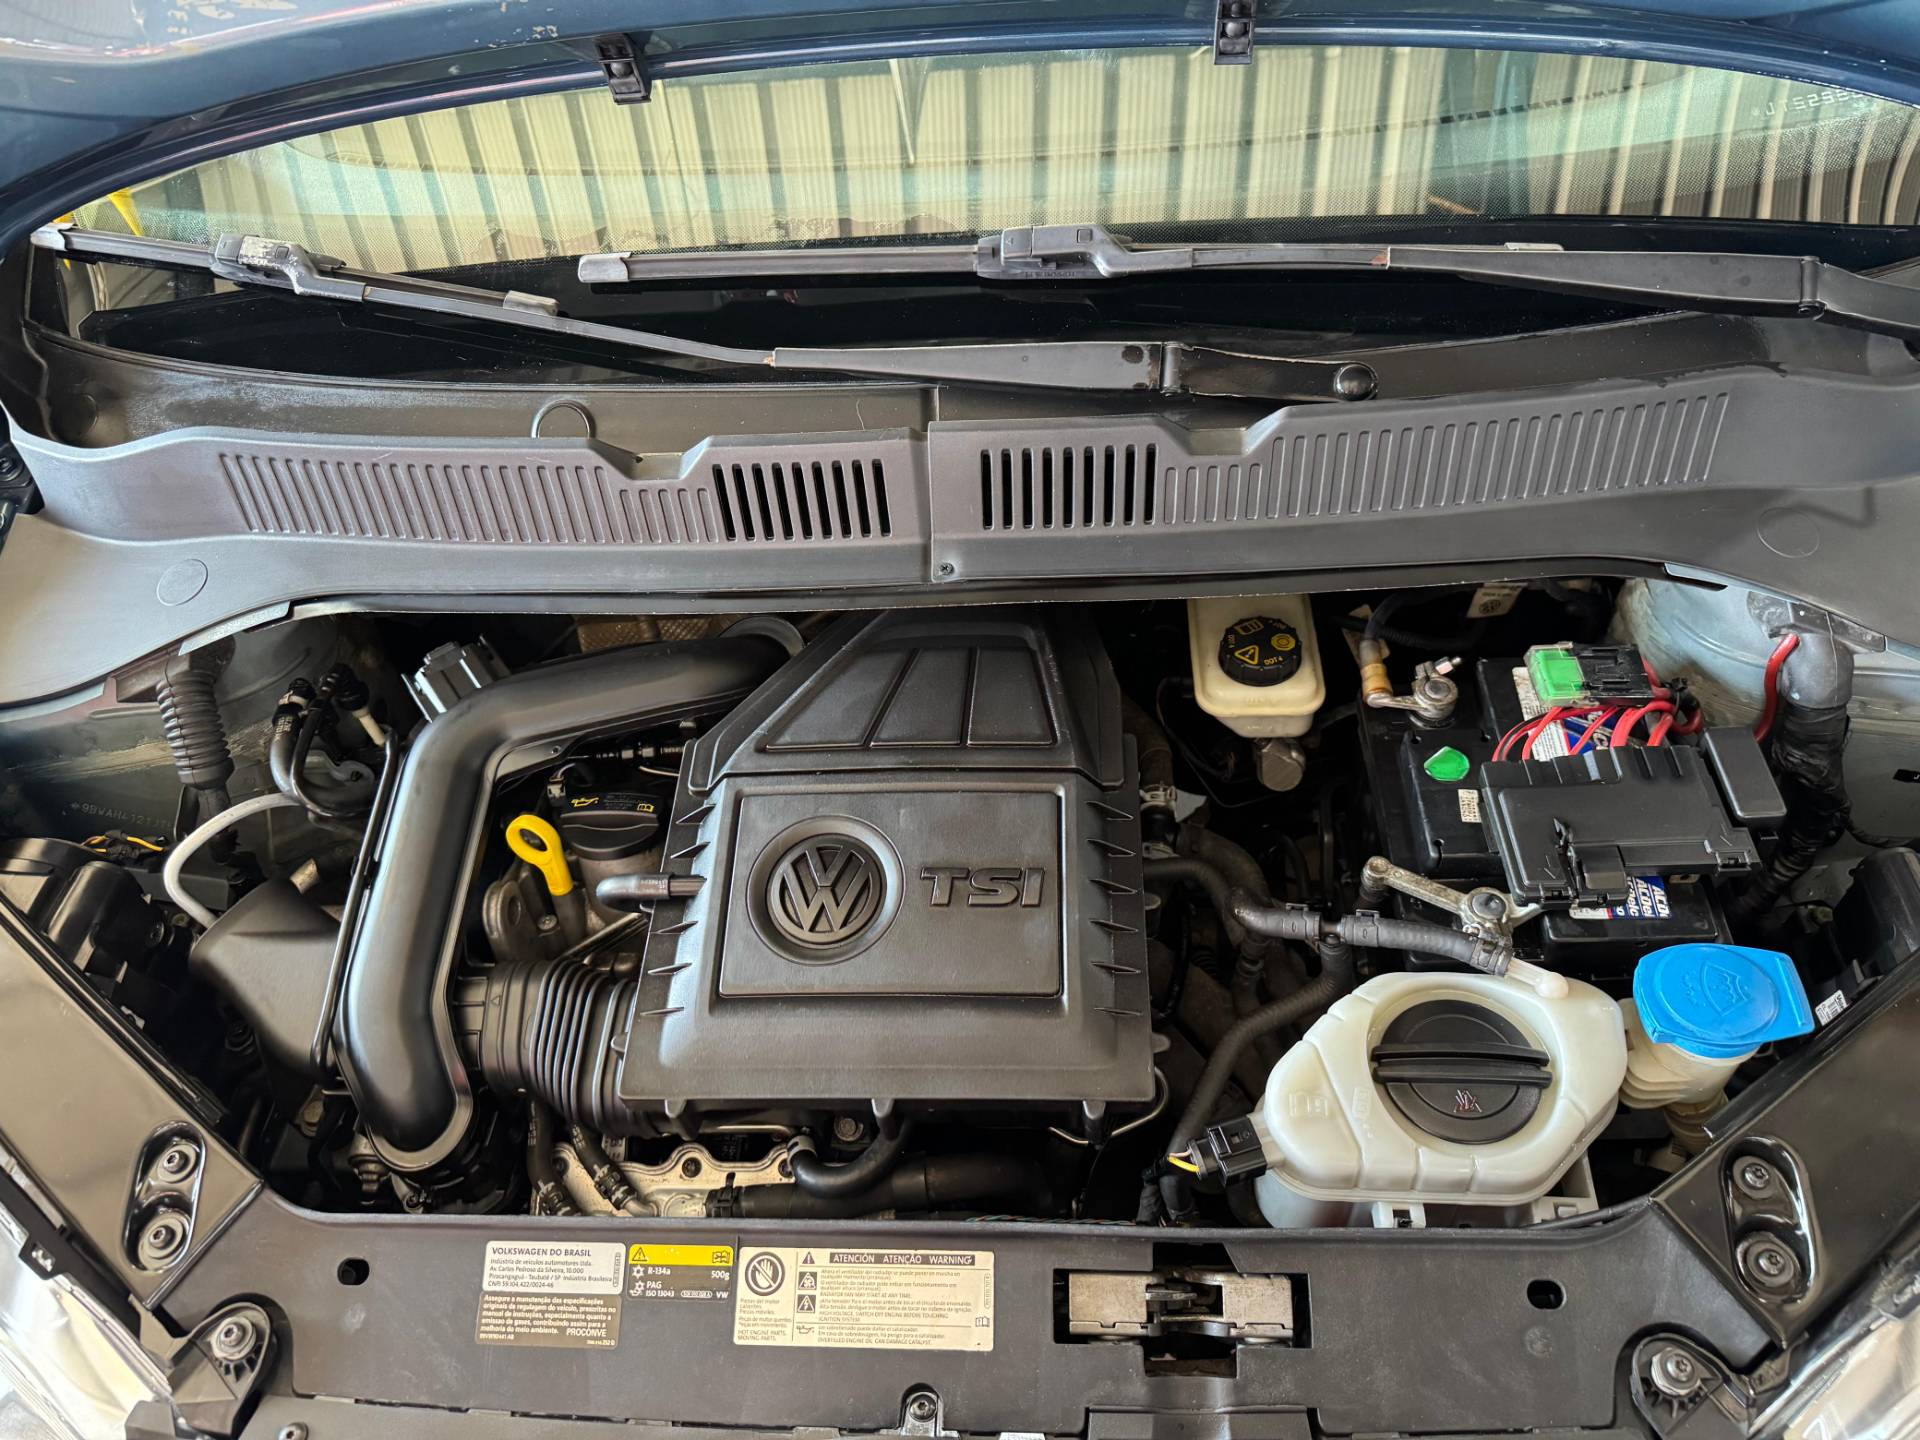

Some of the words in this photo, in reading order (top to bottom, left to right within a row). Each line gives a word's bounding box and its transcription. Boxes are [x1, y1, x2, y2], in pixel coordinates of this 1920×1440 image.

[920, 867, 1046, 907] TSI
[492, 1247, 548, 1256] VOLKSWAGEN
[564, 1249, 592, 1257] BRASIL
[834, 1252, 875, 1263] ATENCIÓN
[883, 1253, 922, 1266] ATENÇÃO
[929, 1256, 972, 1264] WARNING
[648, 1267, 670, 1275] R-134a
[711, 1271, 730, 1280] 500g
[646, 1281, 662, 1289] PAG
[566, 1328, 607, 1338] PROCONVE
